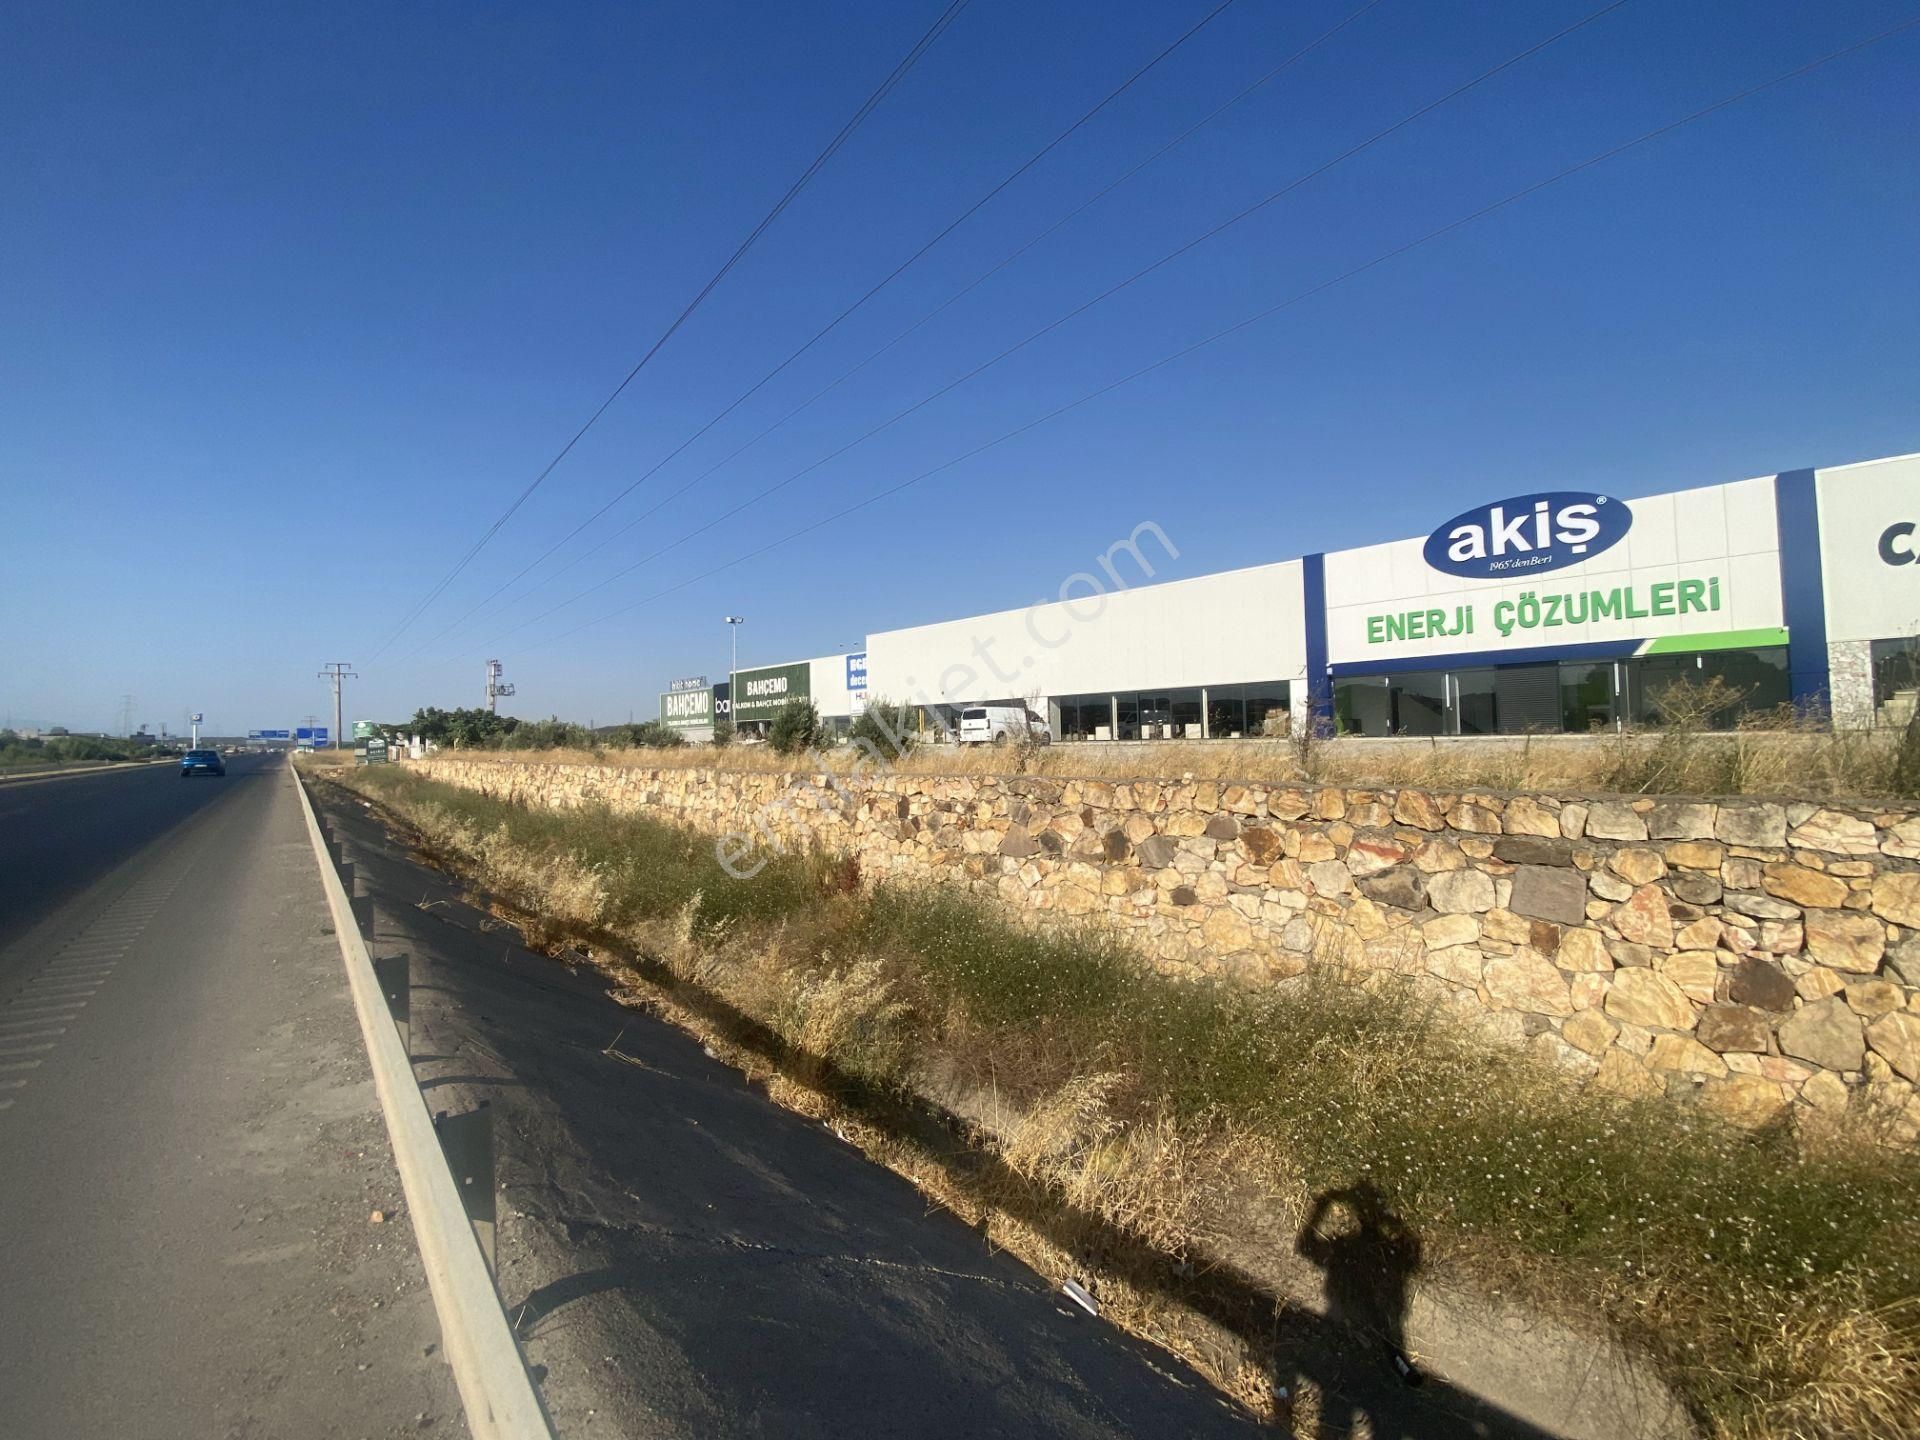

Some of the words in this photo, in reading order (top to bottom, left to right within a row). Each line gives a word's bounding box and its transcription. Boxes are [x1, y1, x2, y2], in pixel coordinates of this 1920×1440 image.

[1448, 501, 1600, 562] akiş
[1878, 521, 1920, 566] C
[667, 691, 709, 717] BAHÇEMO
[747, 677, 788, 696] BAHÇEMO
